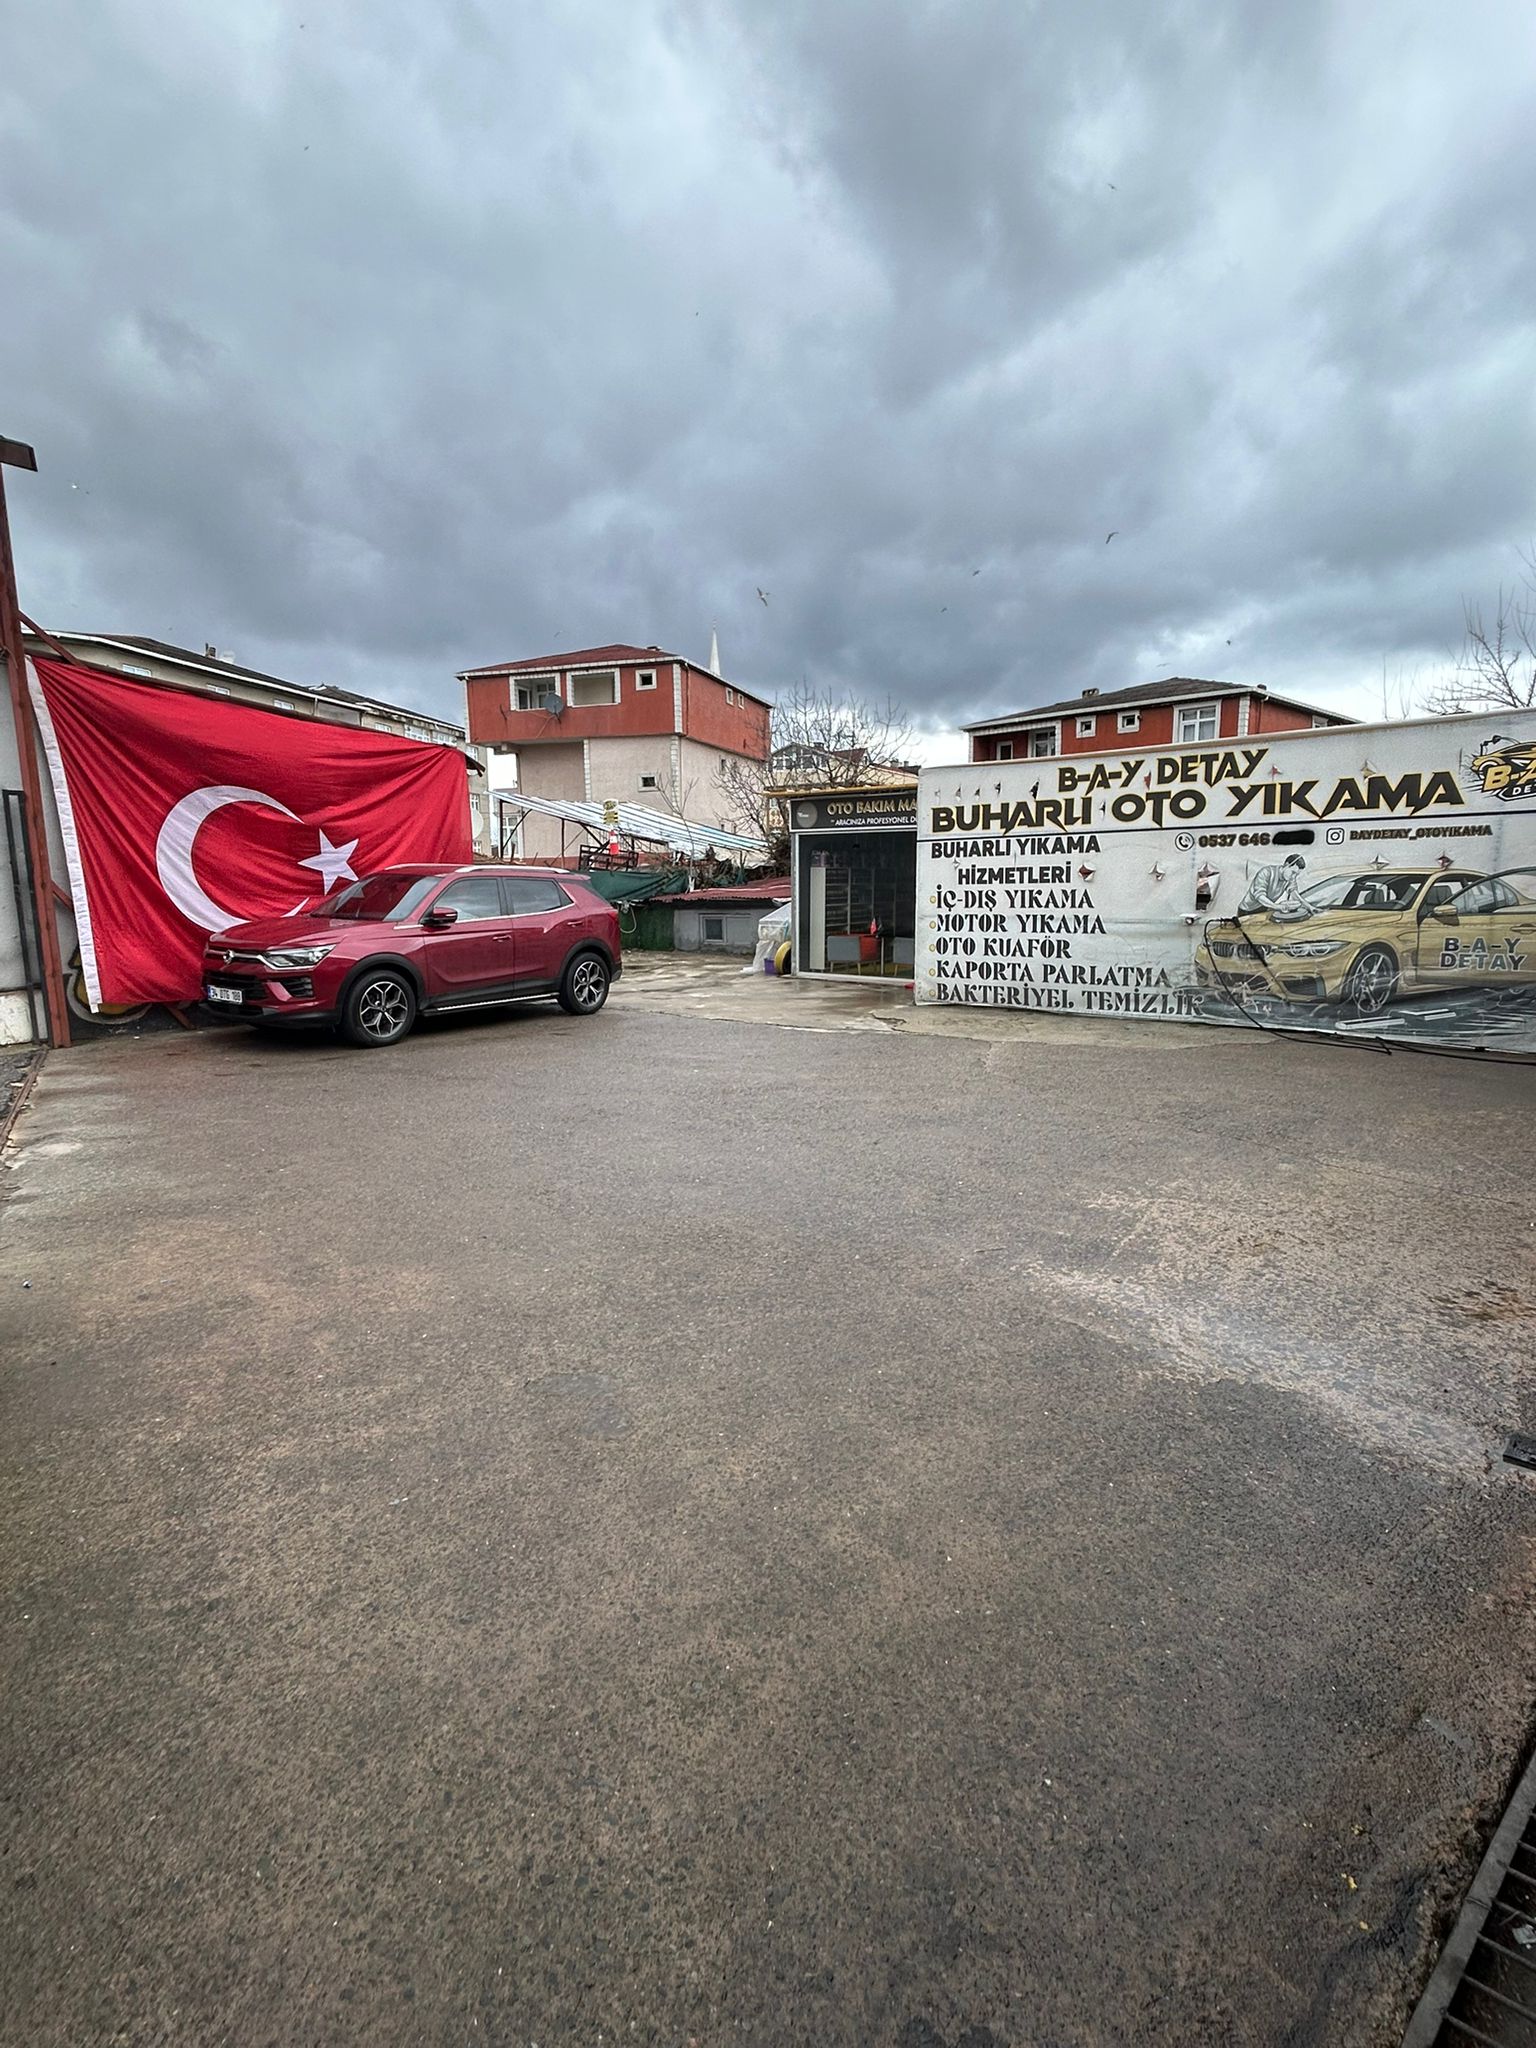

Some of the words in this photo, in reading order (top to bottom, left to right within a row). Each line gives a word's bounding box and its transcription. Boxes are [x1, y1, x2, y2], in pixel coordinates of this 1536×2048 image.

[1058, 759, 1146, 796] B-A-Y
[1156, 748, 1269, 788] DETAY
[1512, 784, 1536, 795] DE
[827, 802, 853, 815] OTO
[857, 800, 895, 813] BAKIM
[931, 796, 1092, 836] BUHARLI
[1112, 789, 1207, 828] OTO
[1225, 771, 1465, 820] YIKAMA
[867, 816, 909, 825] PROFESYONEL
[1198, 833, 1237, 848] 0537
[1238, 832, 1271, 846] 646
[1349, 824, 1493, 841] BAYDETAY_OTOYIKAMA
[931, 839, 1011, 859] BUHARLI
[1016, 835, 1101, 856] YIKAMA
[958, 861, 1072, 885] HİZMETLERİ
[936, 884, 997, 912] İÇ-DIŞ
[1004, 889, 1095, 909] YIKAMA
[937, 913, 1008, 933] MOTOR
[1017, 914, 1107, 935] YIKAMA
[936, 937, 976, 956] OTO
[983, 935, 1072, 959] KUAFÖR
[1443, 936, 1521, 954] B-A-Y
[1440, 952, 1527, 971] DETAY
[936, 960, 1034, 983] KAPORTA
[1042, 964, 1173, 989] PARLATMA
[936, 982, 1075, 1009] BAKTERİYEL
[1082, 988, 1204, 1016] TEMİZLİK
